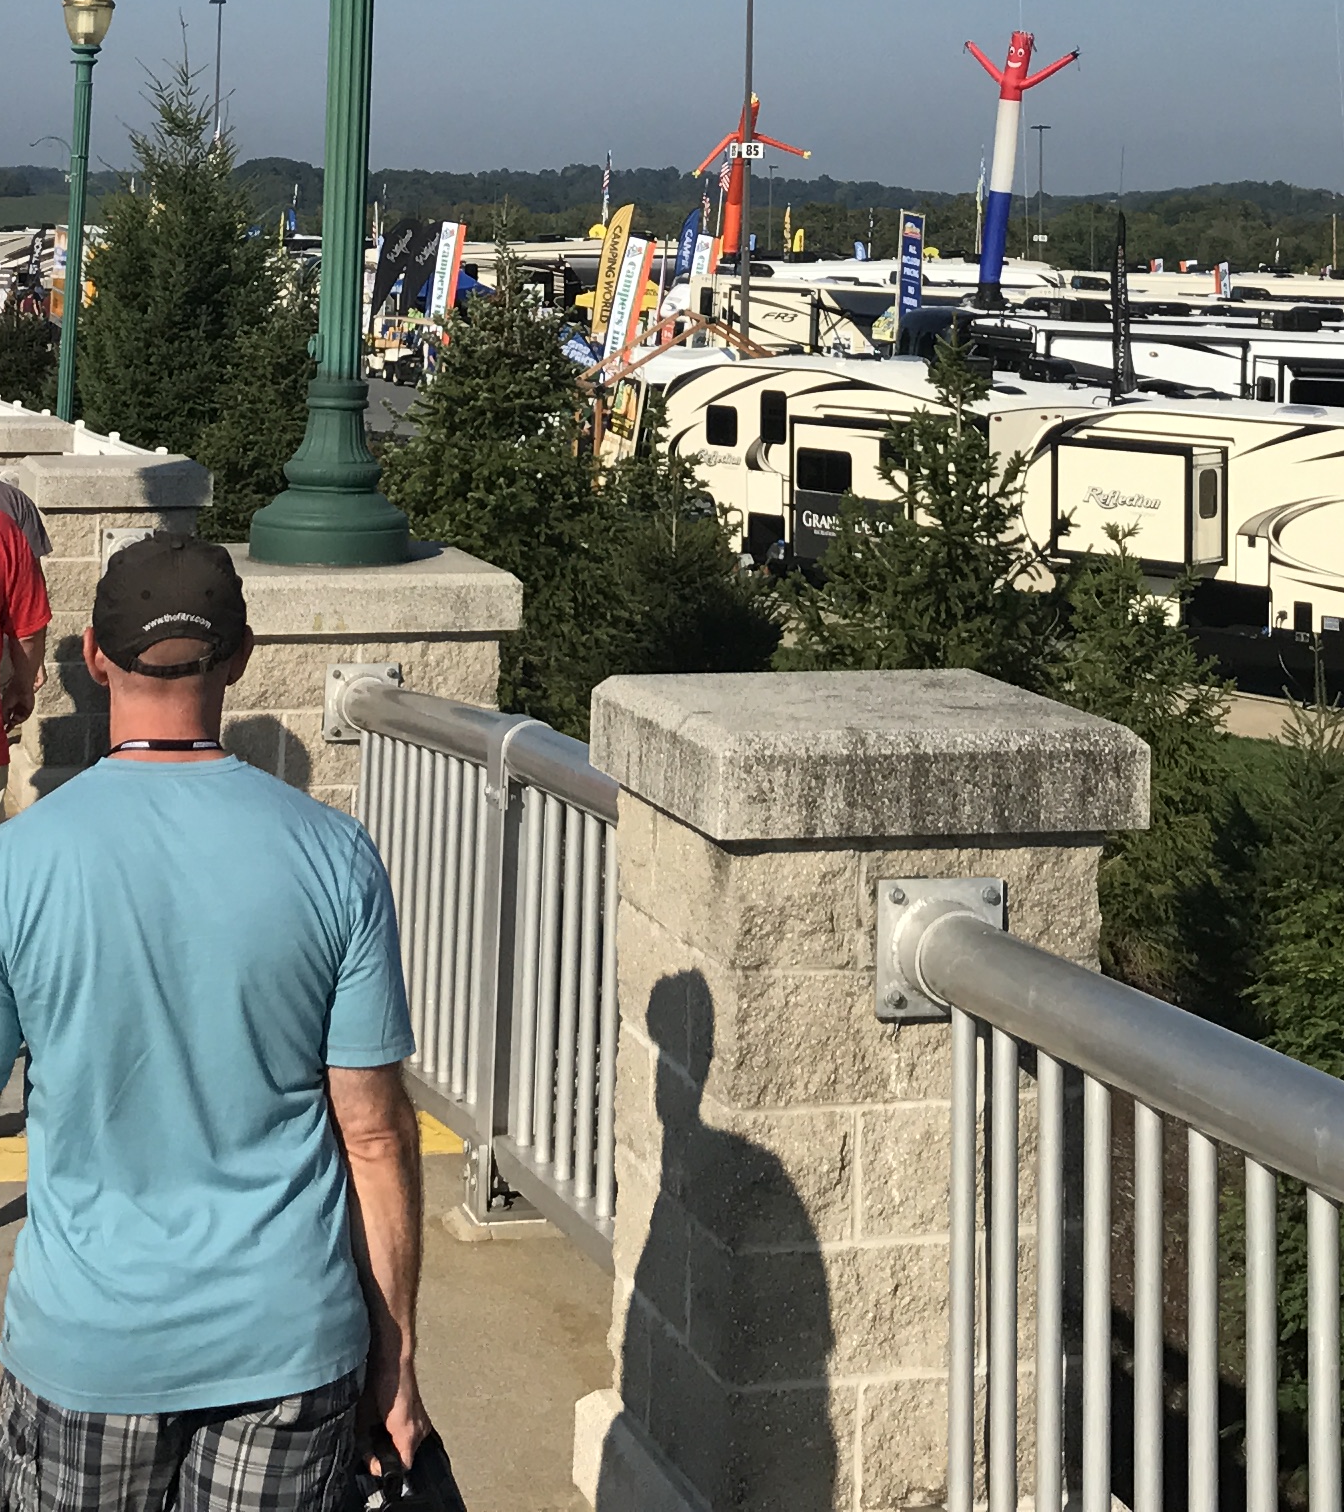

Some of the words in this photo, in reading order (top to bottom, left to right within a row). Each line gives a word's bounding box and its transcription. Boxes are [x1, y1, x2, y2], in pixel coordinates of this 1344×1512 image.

[745, 144, 760, 157] 85
[436, 242, 451, 301] campers
[605, 224, 623, 279] CAMPING
[600, 278, 615, 324] WORLD
[615, 261, 637, 327] campers
[762, 311, 798, 323] FR3
[1082, 485, 1161, 510] Reflection
